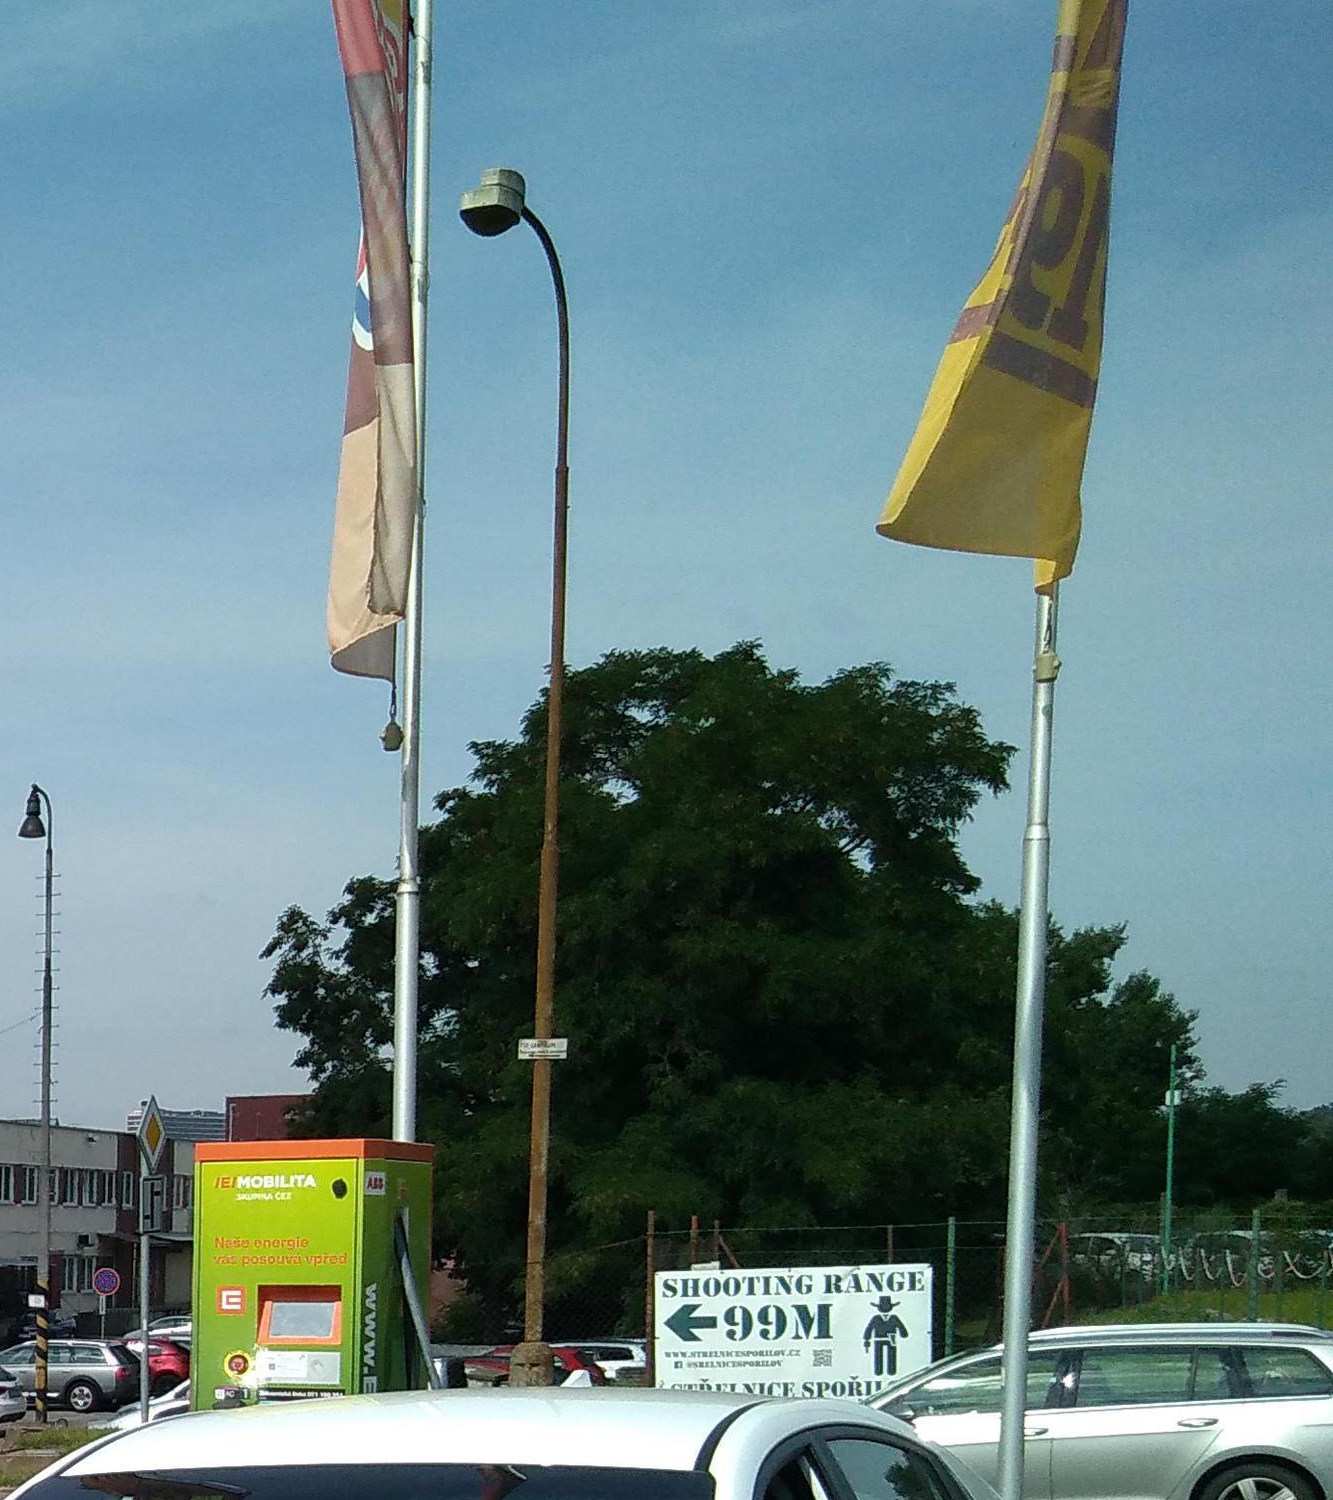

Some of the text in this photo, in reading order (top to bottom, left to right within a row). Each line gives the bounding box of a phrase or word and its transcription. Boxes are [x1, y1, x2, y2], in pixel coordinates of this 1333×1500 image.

[367, 1177, 384, 1190] ABB
[236, 1193, 273, 1201] SKUPINA
[214, 1236, 309, 1250] Naše energie
[662, 1271, 925, 1298] SHOOTING RANGE
[723, 1303, 833, 1341] 99M
